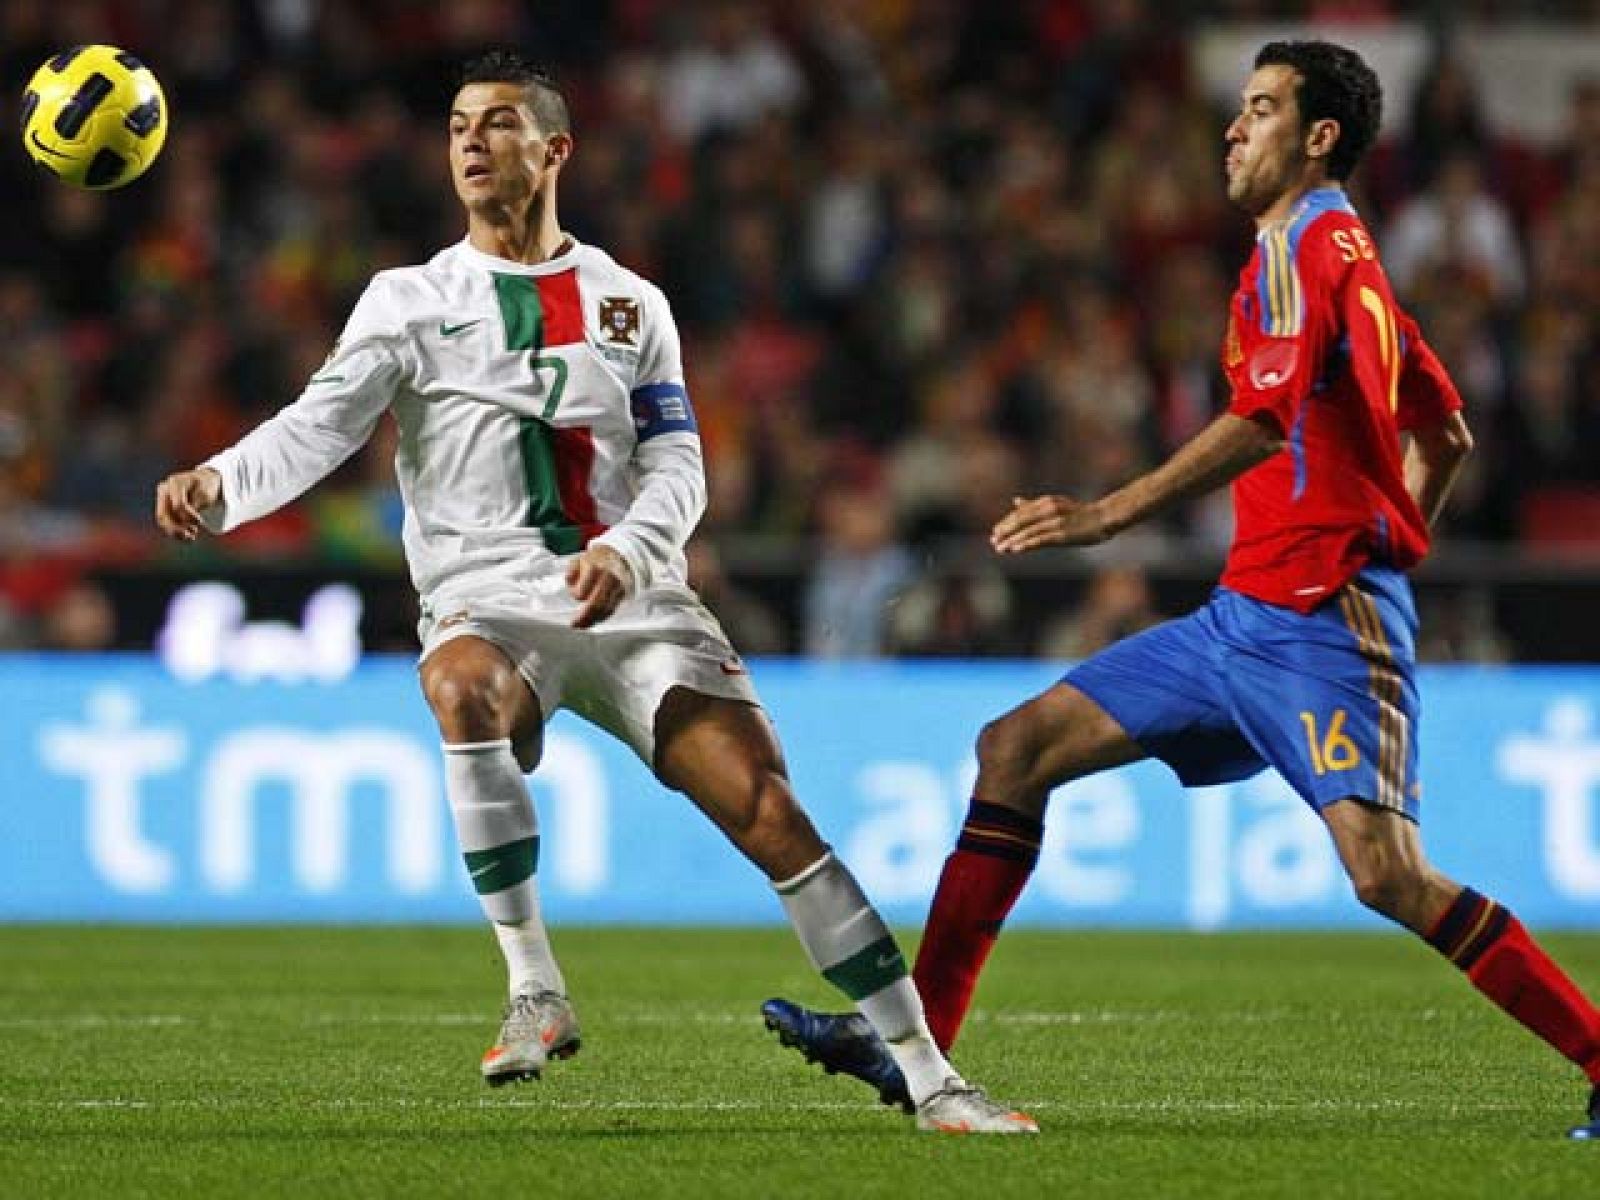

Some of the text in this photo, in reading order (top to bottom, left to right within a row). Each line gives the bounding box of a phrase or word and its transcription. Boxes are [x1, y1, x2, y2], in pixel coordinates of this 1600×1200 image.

[529, 356, 569, 422] 7
[1300, 709, 1360, 775] 16
[40, 690, 608, 894] tmn
